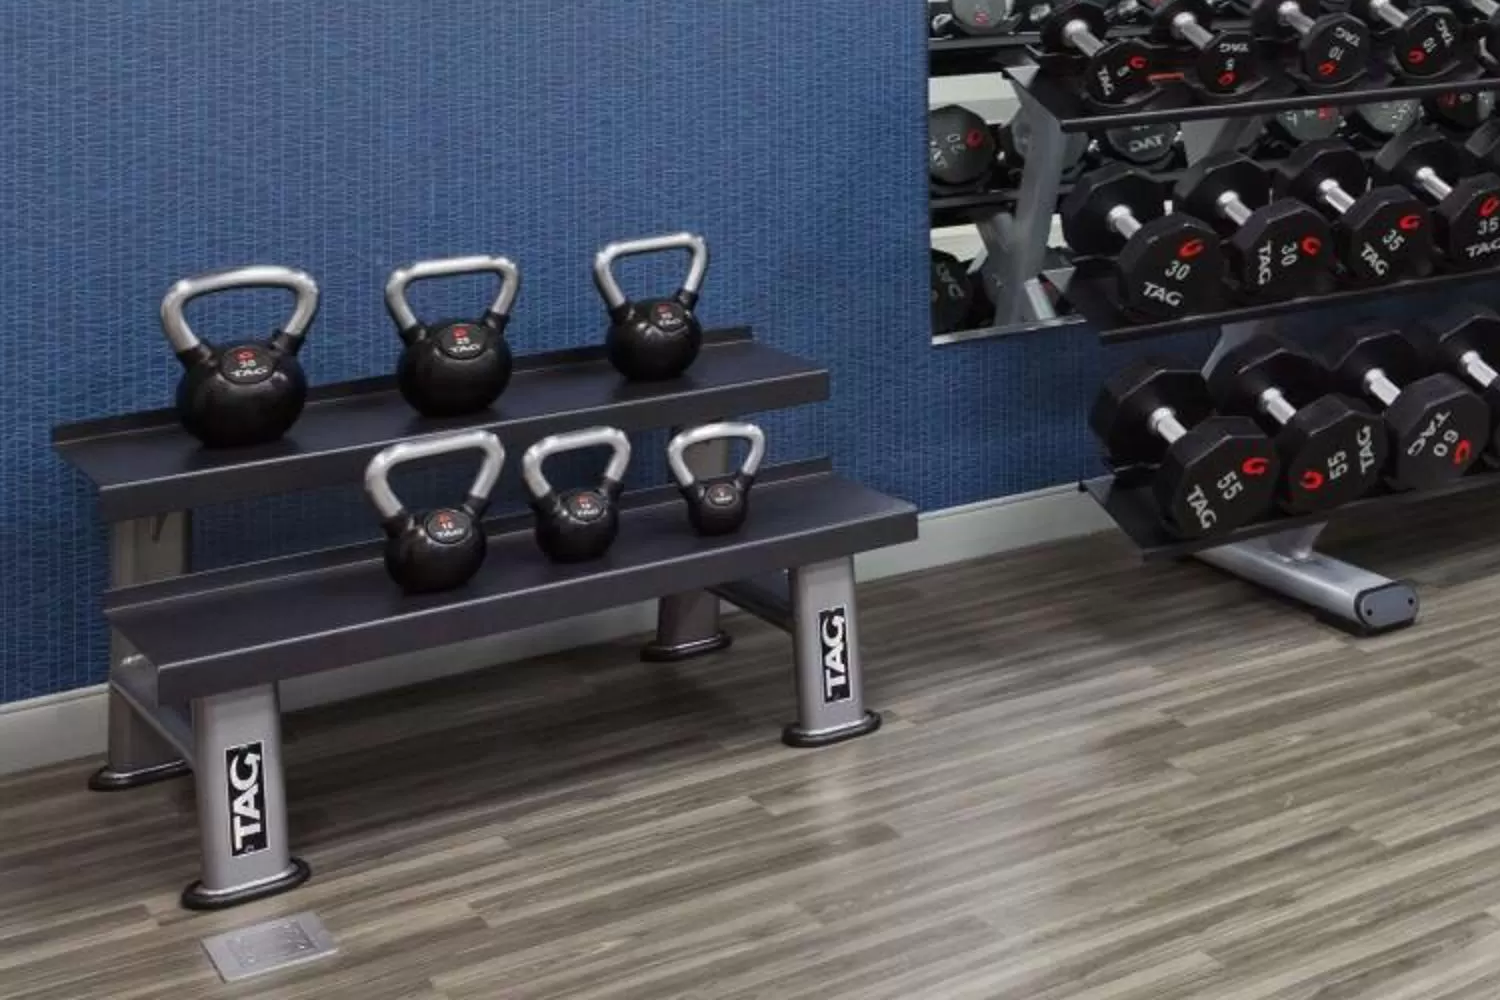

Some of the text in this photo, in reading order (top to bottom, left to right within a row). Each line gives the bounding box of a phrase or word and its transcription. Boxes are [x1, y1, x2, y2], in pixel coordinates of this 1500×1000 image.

[1335, 27, 1360, 47] TAG
[1435, 17, 1454, 47] TAG
[1219, 43, 1249, 53] TAG
[1328, 45, 1344, 61] 10
[1098, 66, 1114, 96] TAG
[1381, 228, 1406, 251] 35
[1477, 217, 1500, 236] 35
[1258, 240, 1272, 285] TAG
[1281, 242, 1298, 267] 30
[1361, 242, 1389, 276] TAG
[1164, 260, 1191, 280] 30
[1143, 282, 1184, 307] TAG
[448, 343, 481, 353] TAG
[229, 366, 268, 377] TAG
[1407, 411, 1451, 456] TAG
[1433, 429, 1459, 457] 60
[1357, 425, 1375, 475] TAG
[1327, 451, 1349, 480] 55
[1217, 471, 1244, 501] 55
[1187, 484, 1217, 530] TAG
[822, 615, 846, 697] TAG
[229, 753, 261, 850] TAG
